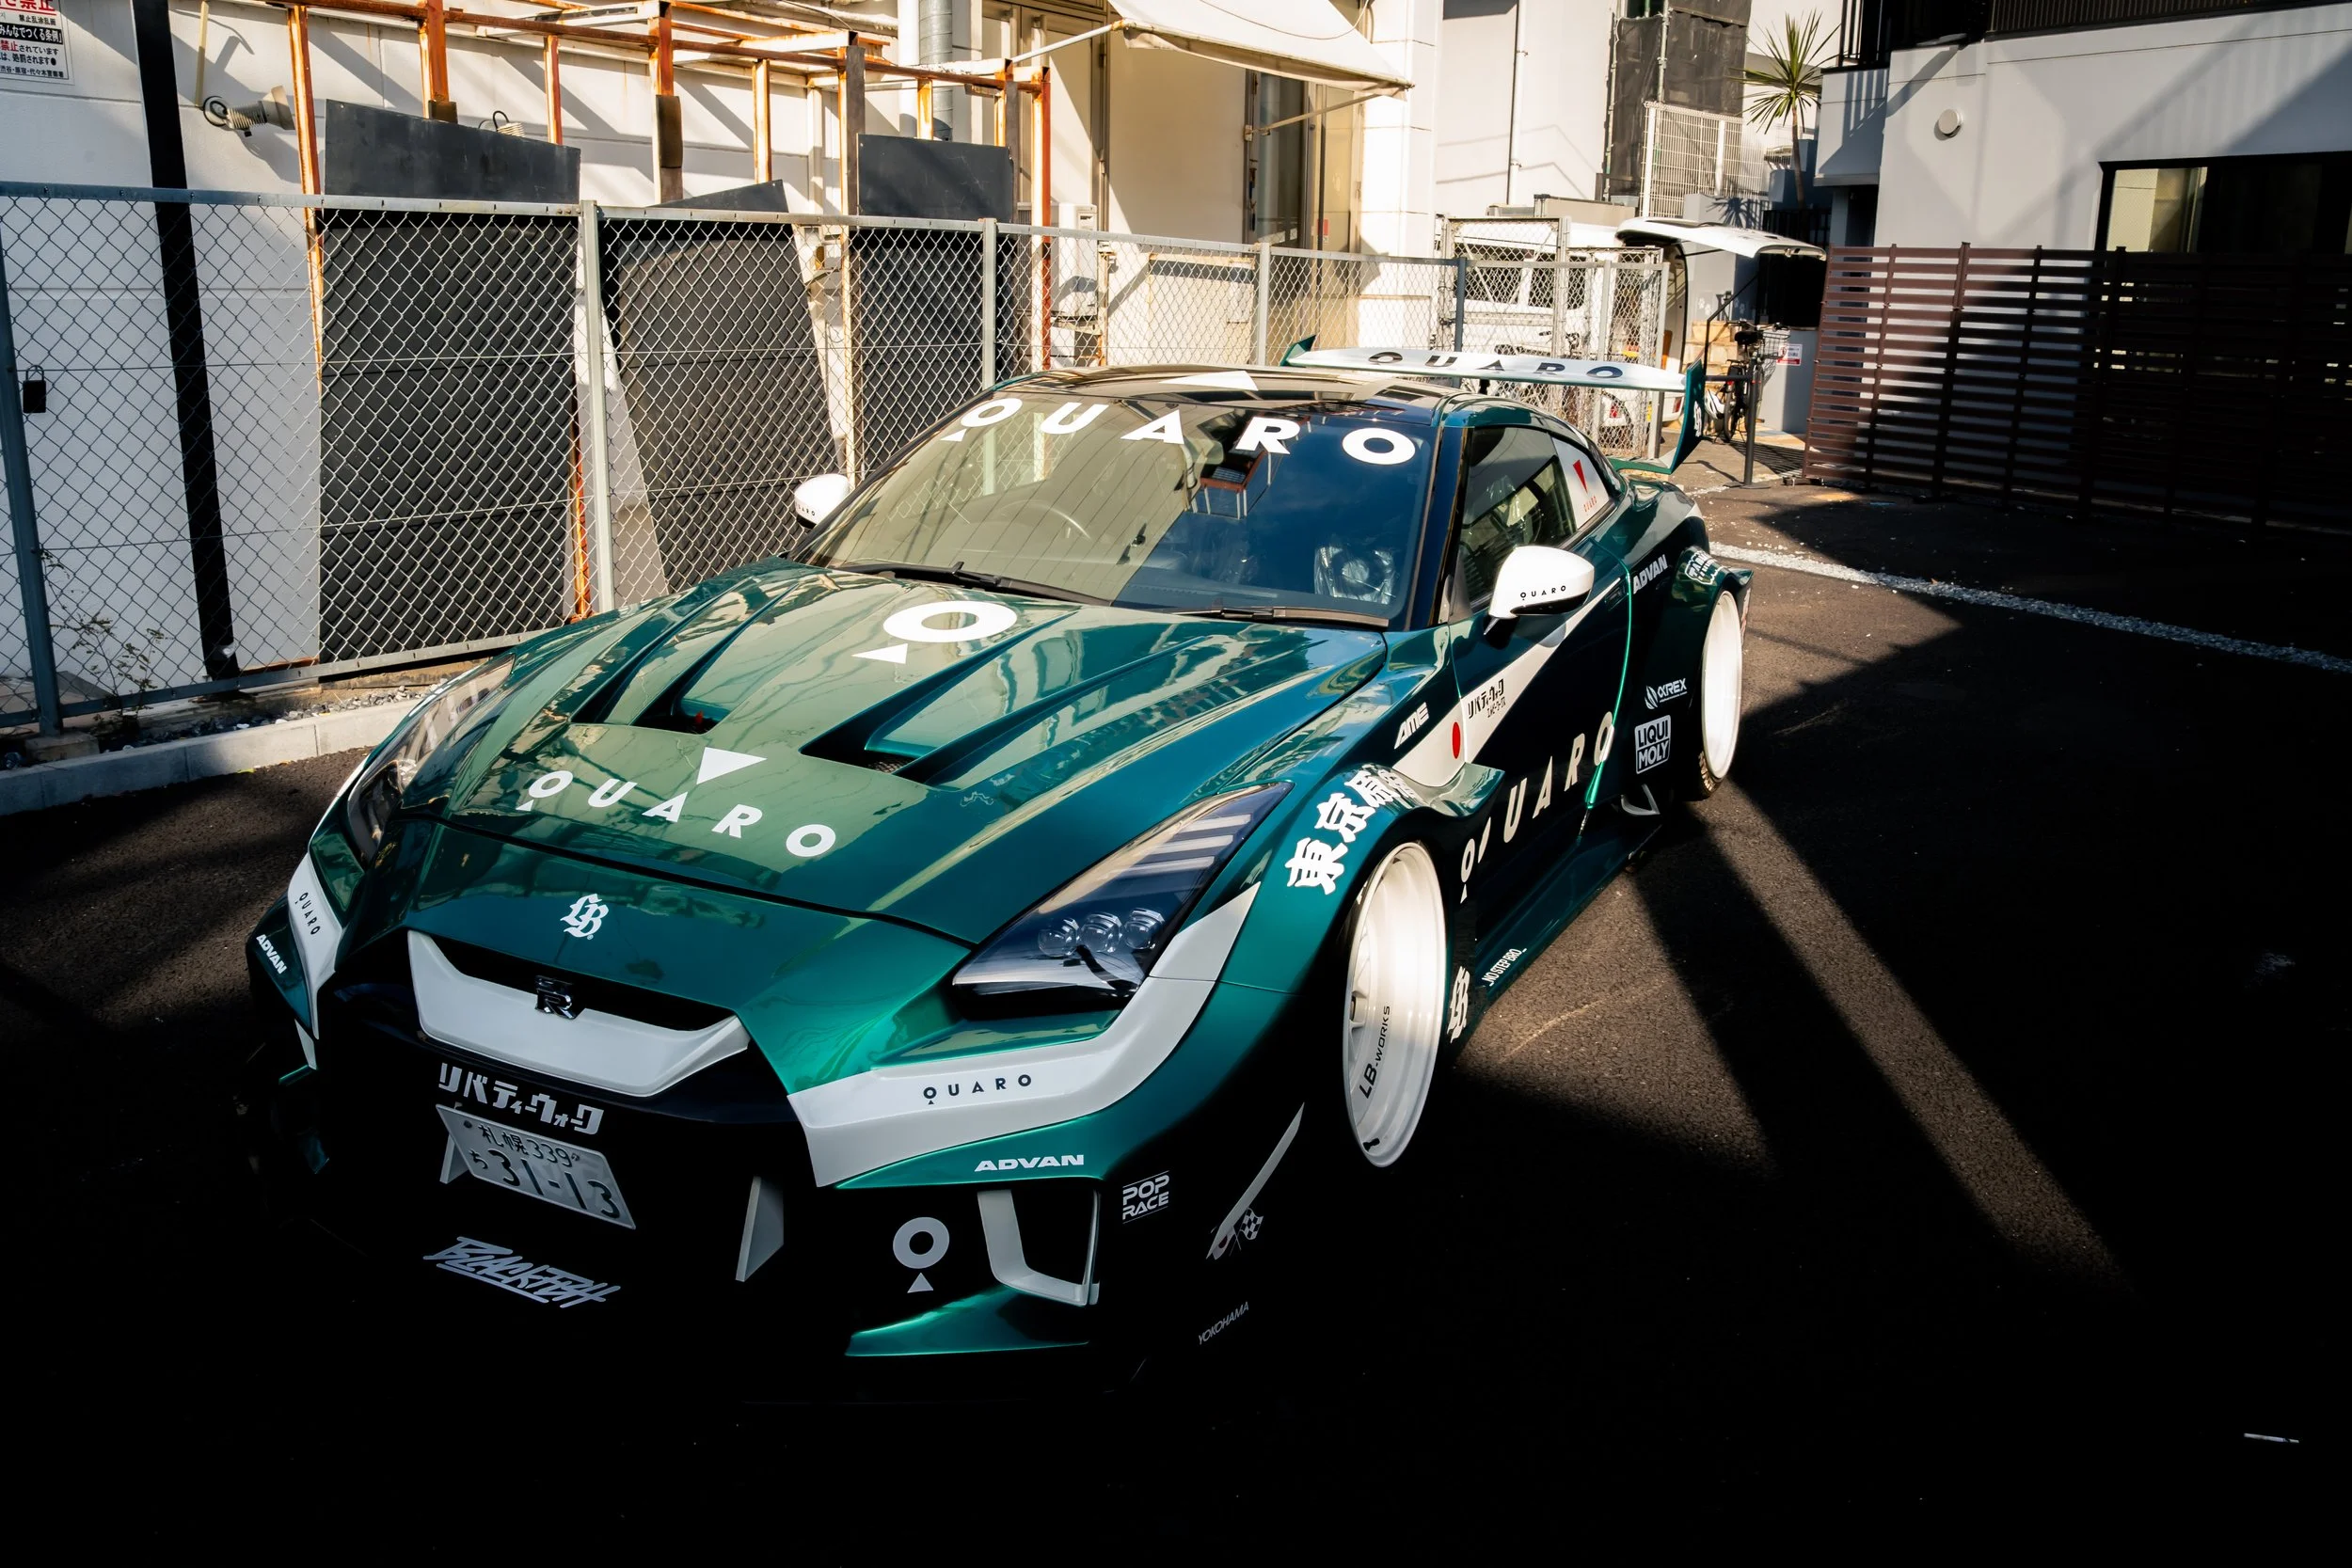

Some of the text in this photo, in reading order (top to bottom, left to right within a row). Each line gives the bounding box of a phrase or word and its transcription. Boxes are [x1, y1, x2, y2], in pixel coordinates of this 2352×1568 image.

[1368, 351, 1623, 378] QUARO
[940, 398, 1416, 466] QUARO
[1633, 554, 1668, 594] ADVAN
[1520, 585, 1566, 601] QUARO
[1394, 702, 1429, 750] AME
[1638, 720, 1669, 748] LIQUI
[1639, 739, 1670, 769] MOLY
[516, 770, 836, 857] QUARO
[1460, 711, 1614, 904] QUARO
[294, 893, 321, 935] QUARO
[256, 934, 287, 974] ADVAN
[923, 1074, 1032, 1105] QUARO
[974, 1154, 1085, 1172] ADVAN
[1122, 1175, 1170, 1206] POP
[1122, 1191, 1169, 1221] RACE
[1198, 1300, 1249, 1345] YOKOHAMA
